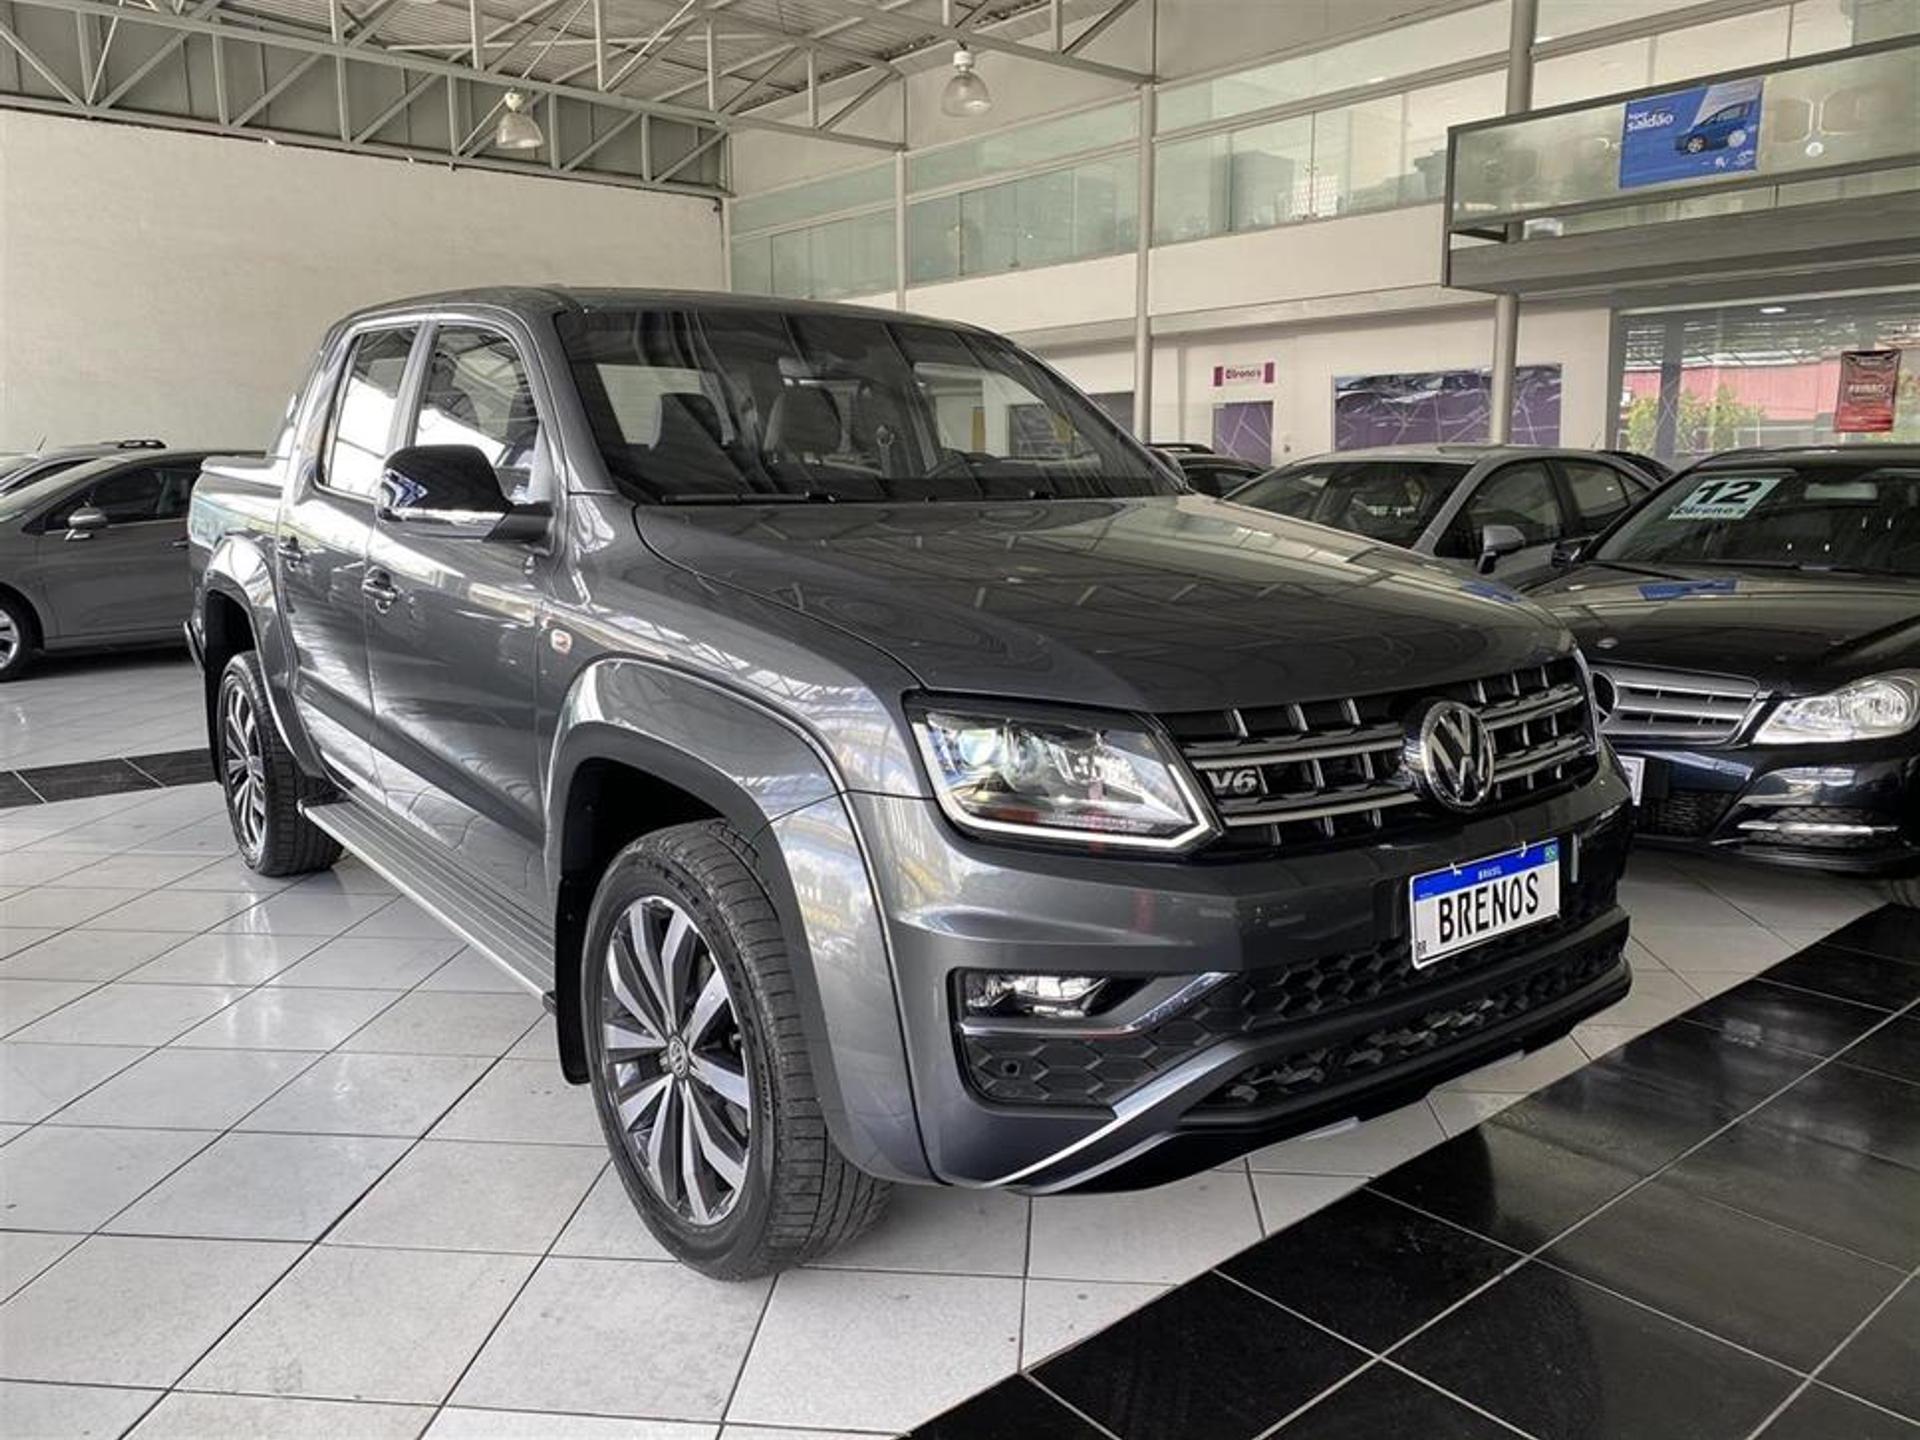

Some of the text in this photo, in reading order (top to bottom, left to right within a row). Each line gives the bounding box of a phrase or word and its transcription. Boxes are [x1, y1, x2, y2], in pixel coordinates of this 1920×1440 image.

[1696, 482, 1762, 504] 12
[1207, 769, 1258, 795] V6
[1439, 872, 1539, 943] BRENOS
